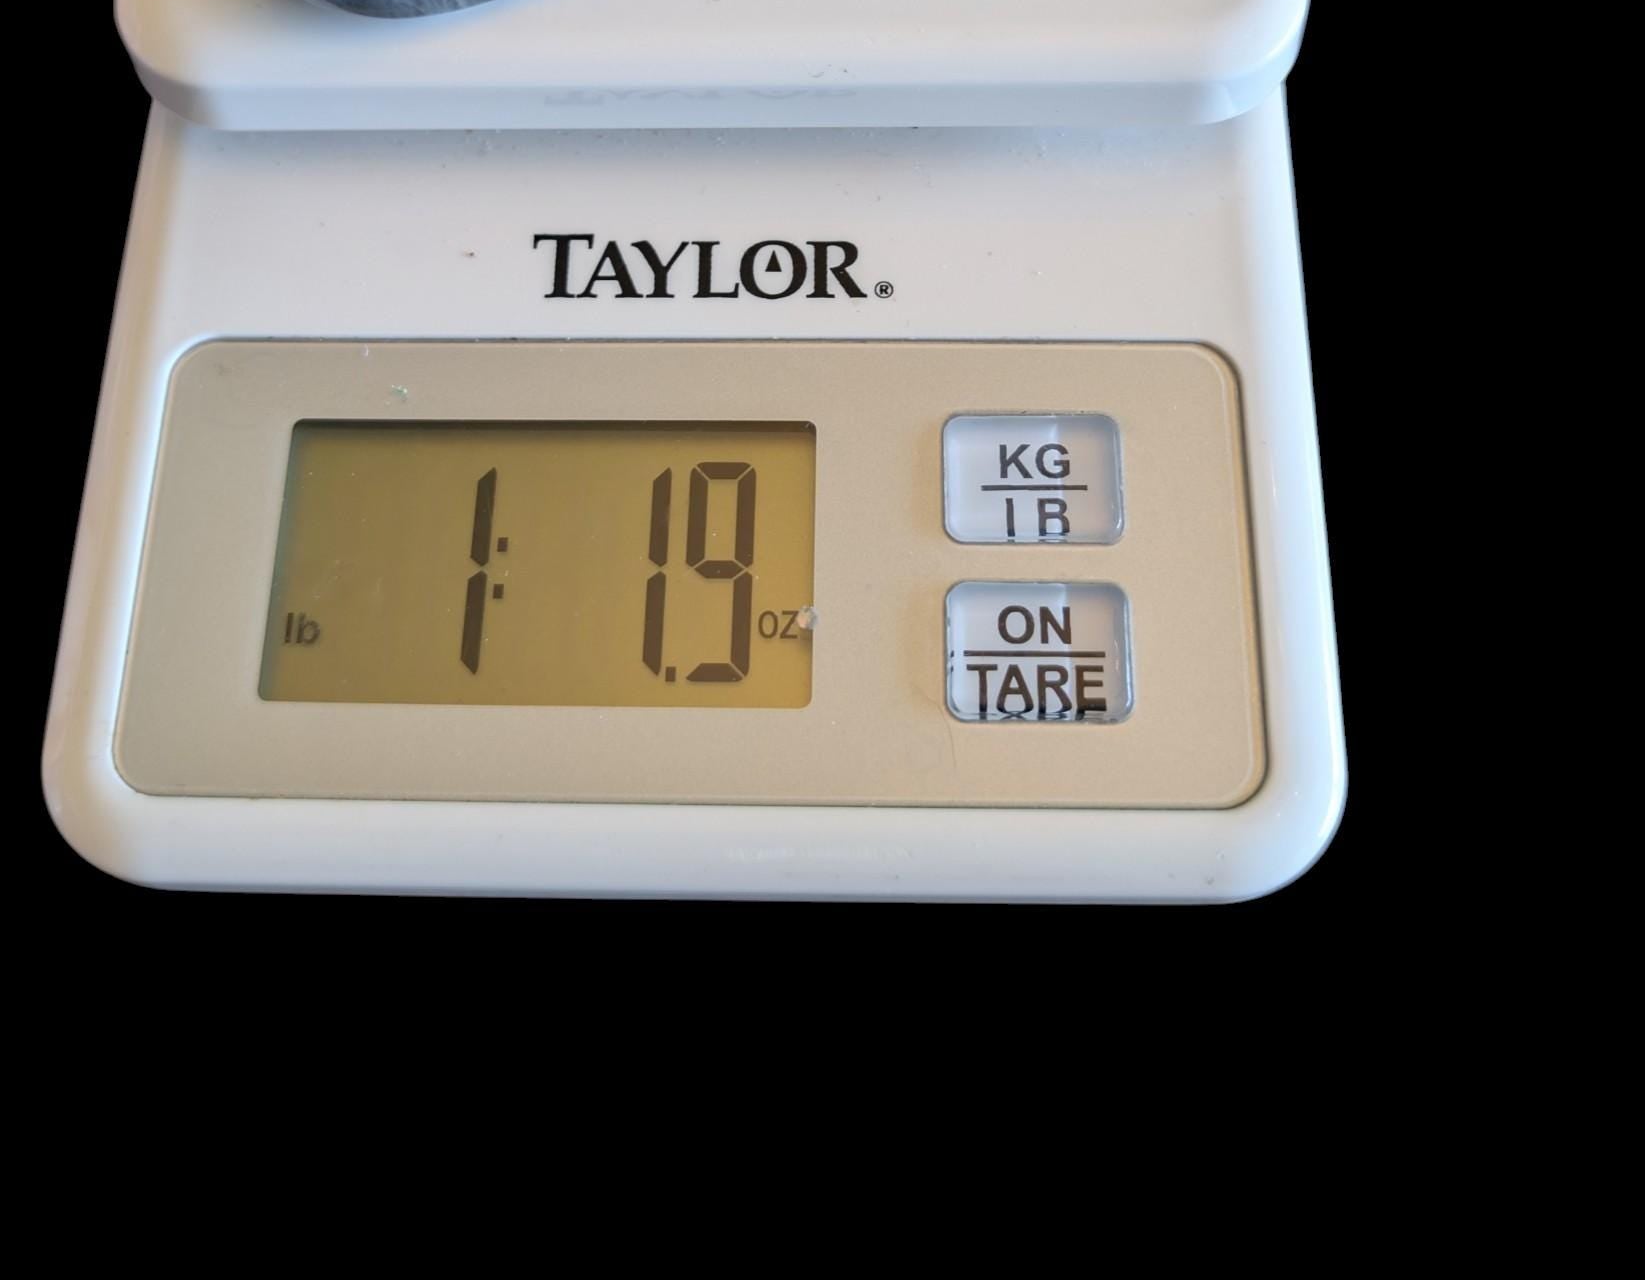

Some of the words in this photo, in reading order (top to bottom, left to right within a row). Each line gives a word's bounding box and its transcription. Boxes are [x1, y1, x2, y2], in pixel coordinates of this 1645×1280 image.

[999, 442, 1071, 480] KG
[642, 461, 757, 683] 1.9
[997, 605, 1072, 645] ON
[966, 663, 1107, 718] TARE
